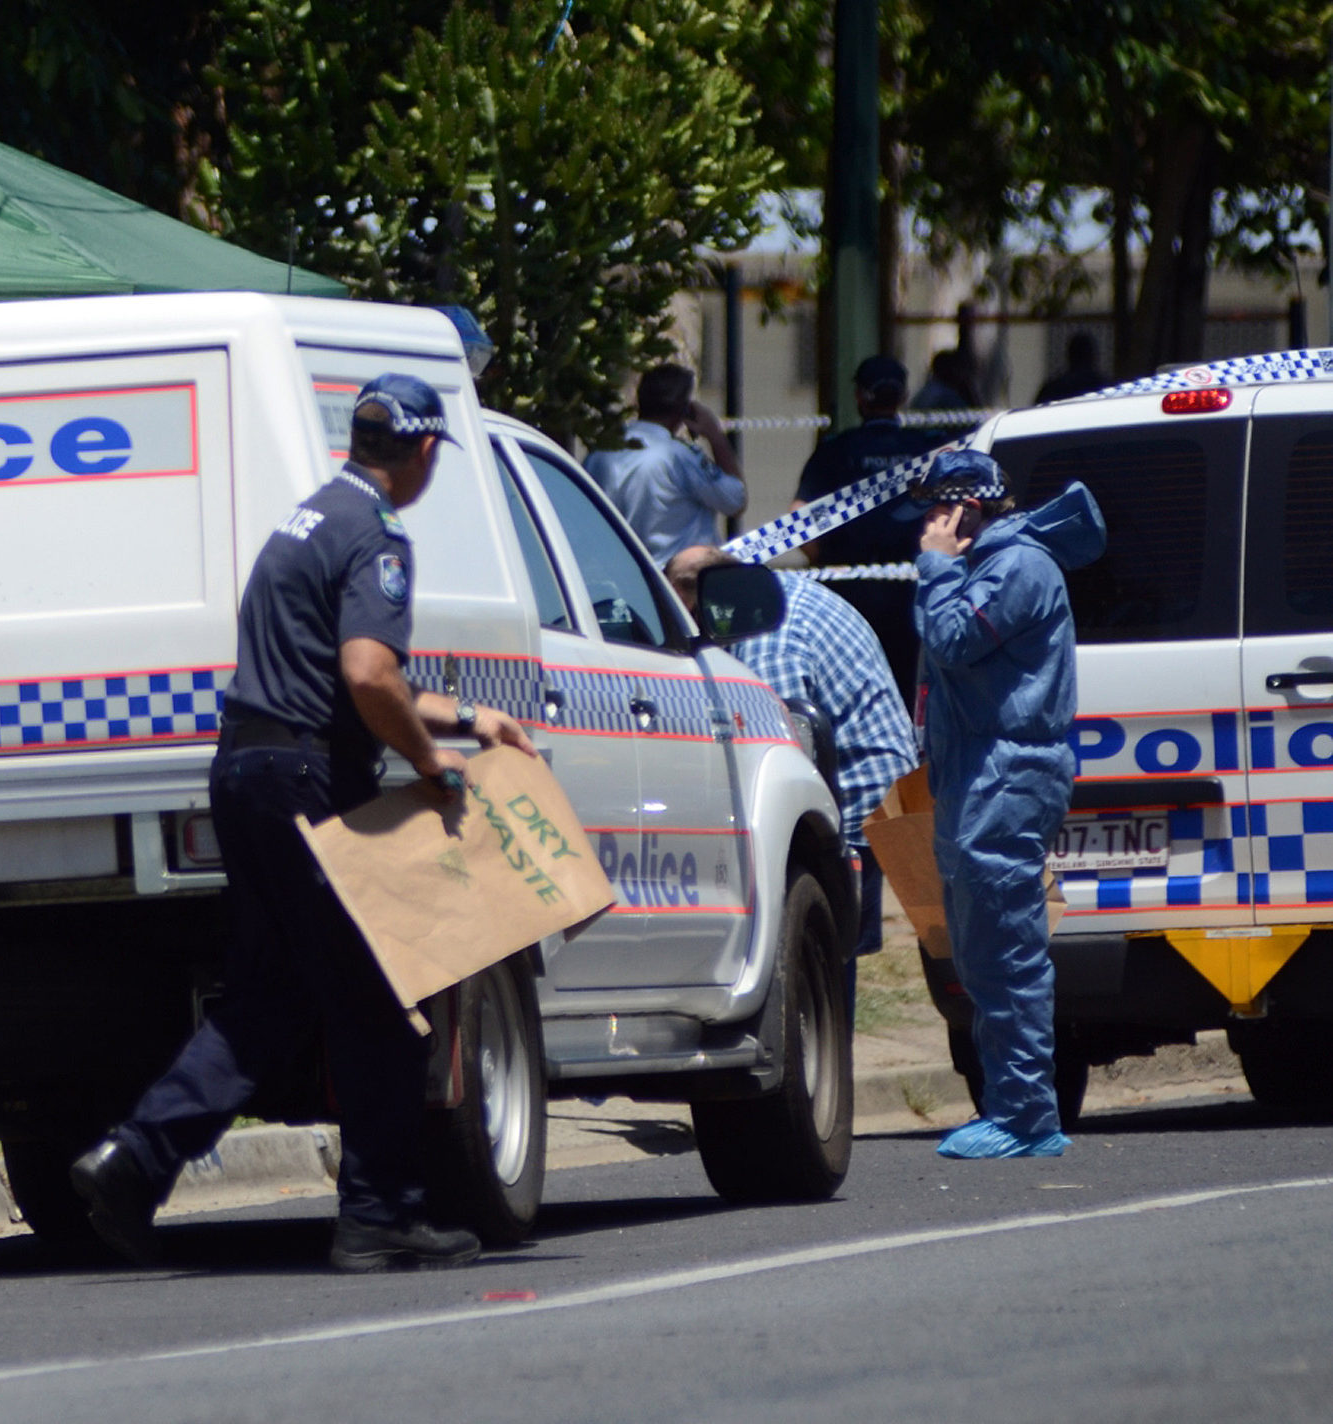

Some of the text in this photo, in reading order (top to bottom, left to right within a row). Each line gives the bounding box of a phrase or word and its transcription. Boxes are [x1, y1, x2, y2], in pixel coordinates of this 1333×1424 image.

[1067, 710, 1333, 777] Polic
[468, 784, 566, 905] WASTE
[506, 793, 582, 861] DRY
[599, 832, 699, 907] Police
